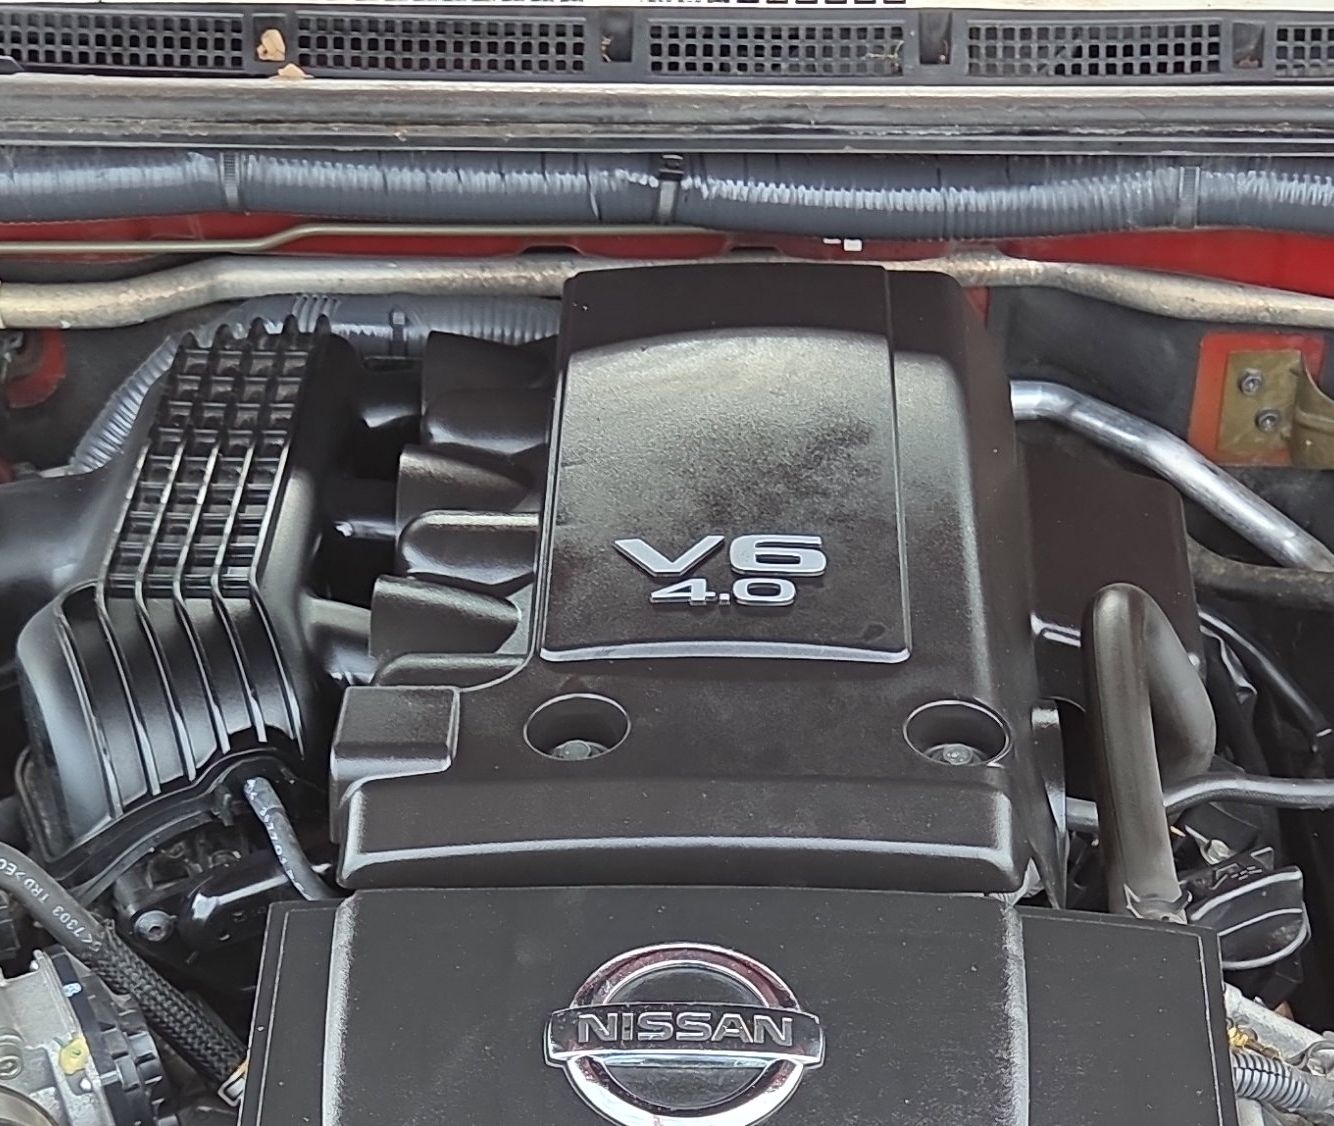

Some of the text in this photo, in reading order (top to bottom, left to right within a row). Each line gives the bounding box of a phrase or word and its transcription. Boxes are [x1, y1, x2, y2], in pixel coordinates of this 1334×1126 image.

[615, 533, 827, 579] V6
[648, 576, 797, 607] 4.0
[578, 1013, 794, 1048] NISSAN
